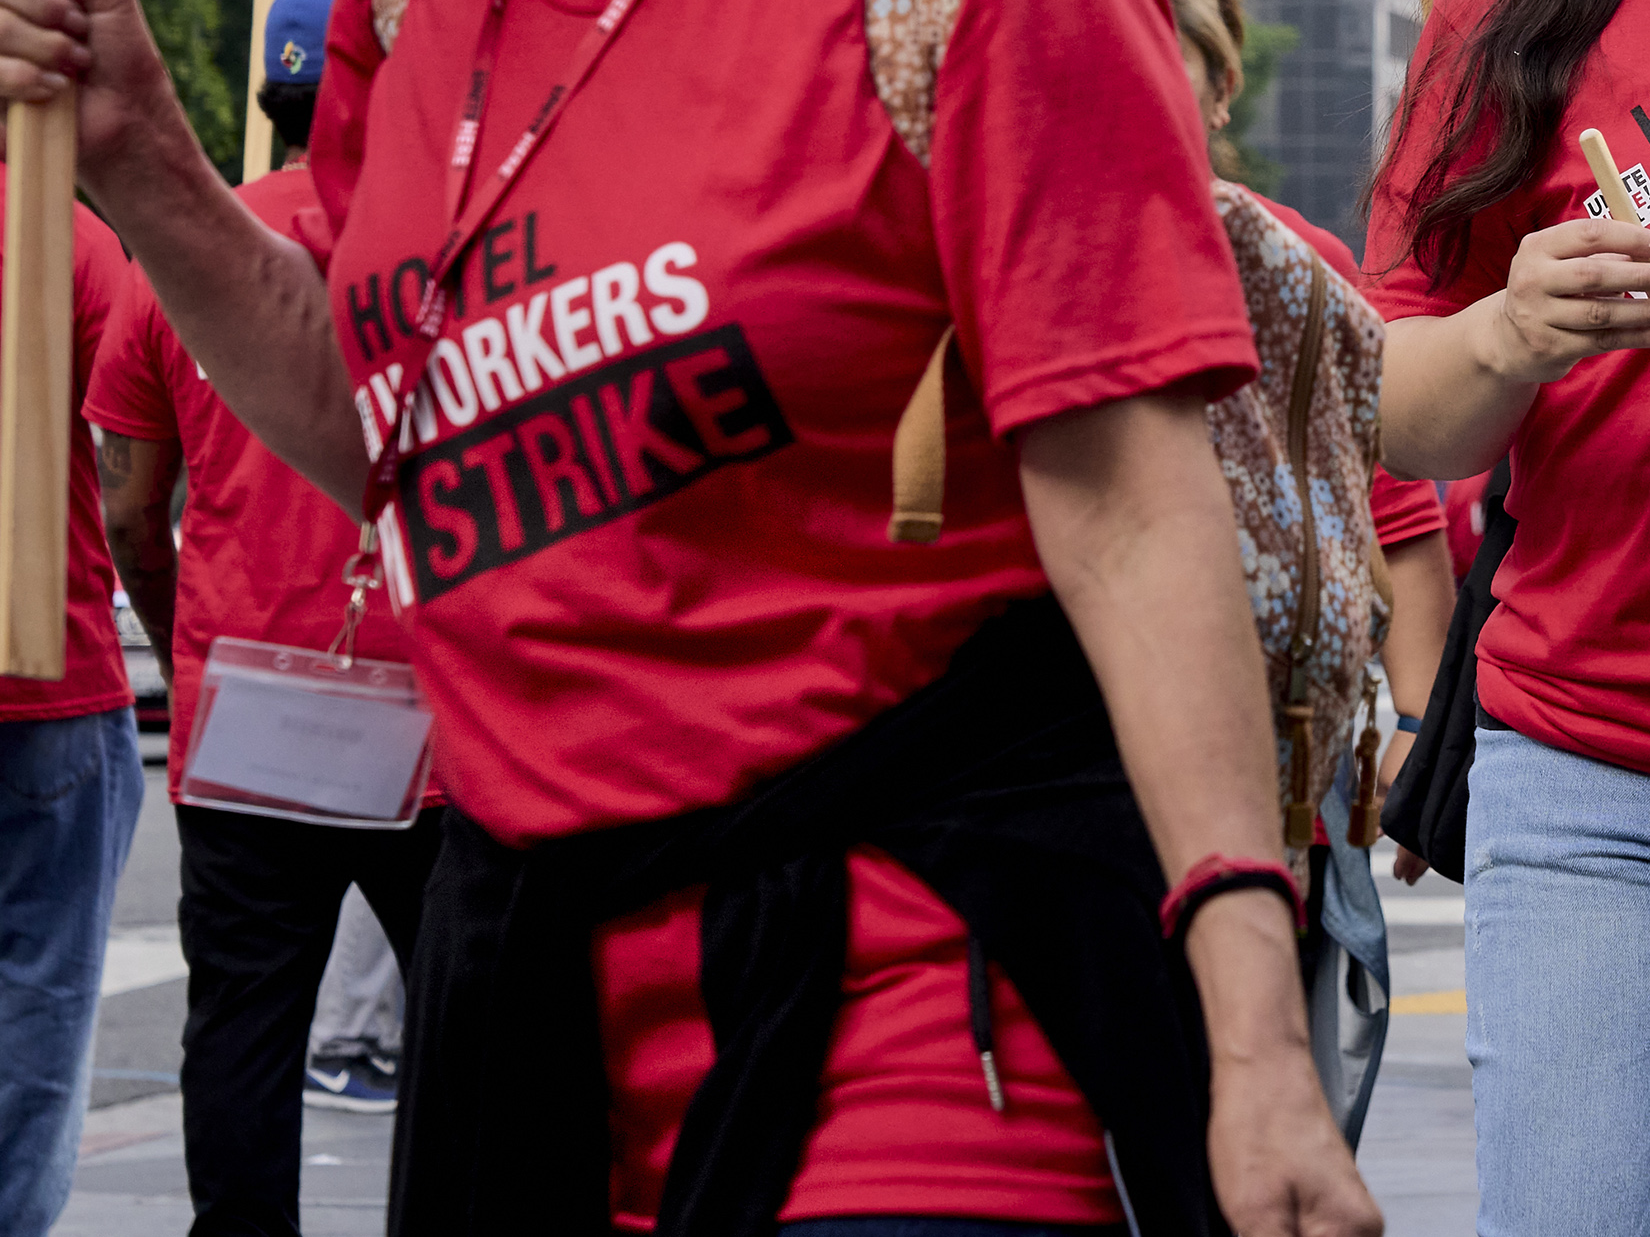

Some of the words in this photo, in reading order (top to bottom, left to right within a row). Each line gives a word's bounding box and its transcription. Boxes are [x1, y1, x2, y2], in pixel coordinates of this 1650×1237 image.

[1587, 169, 1647, 217] UTE
[348, 212, 557, 362] HOEL
[369, 242, 709, 454] WORKERS
[418, 345, 772, 580] STRIKE
